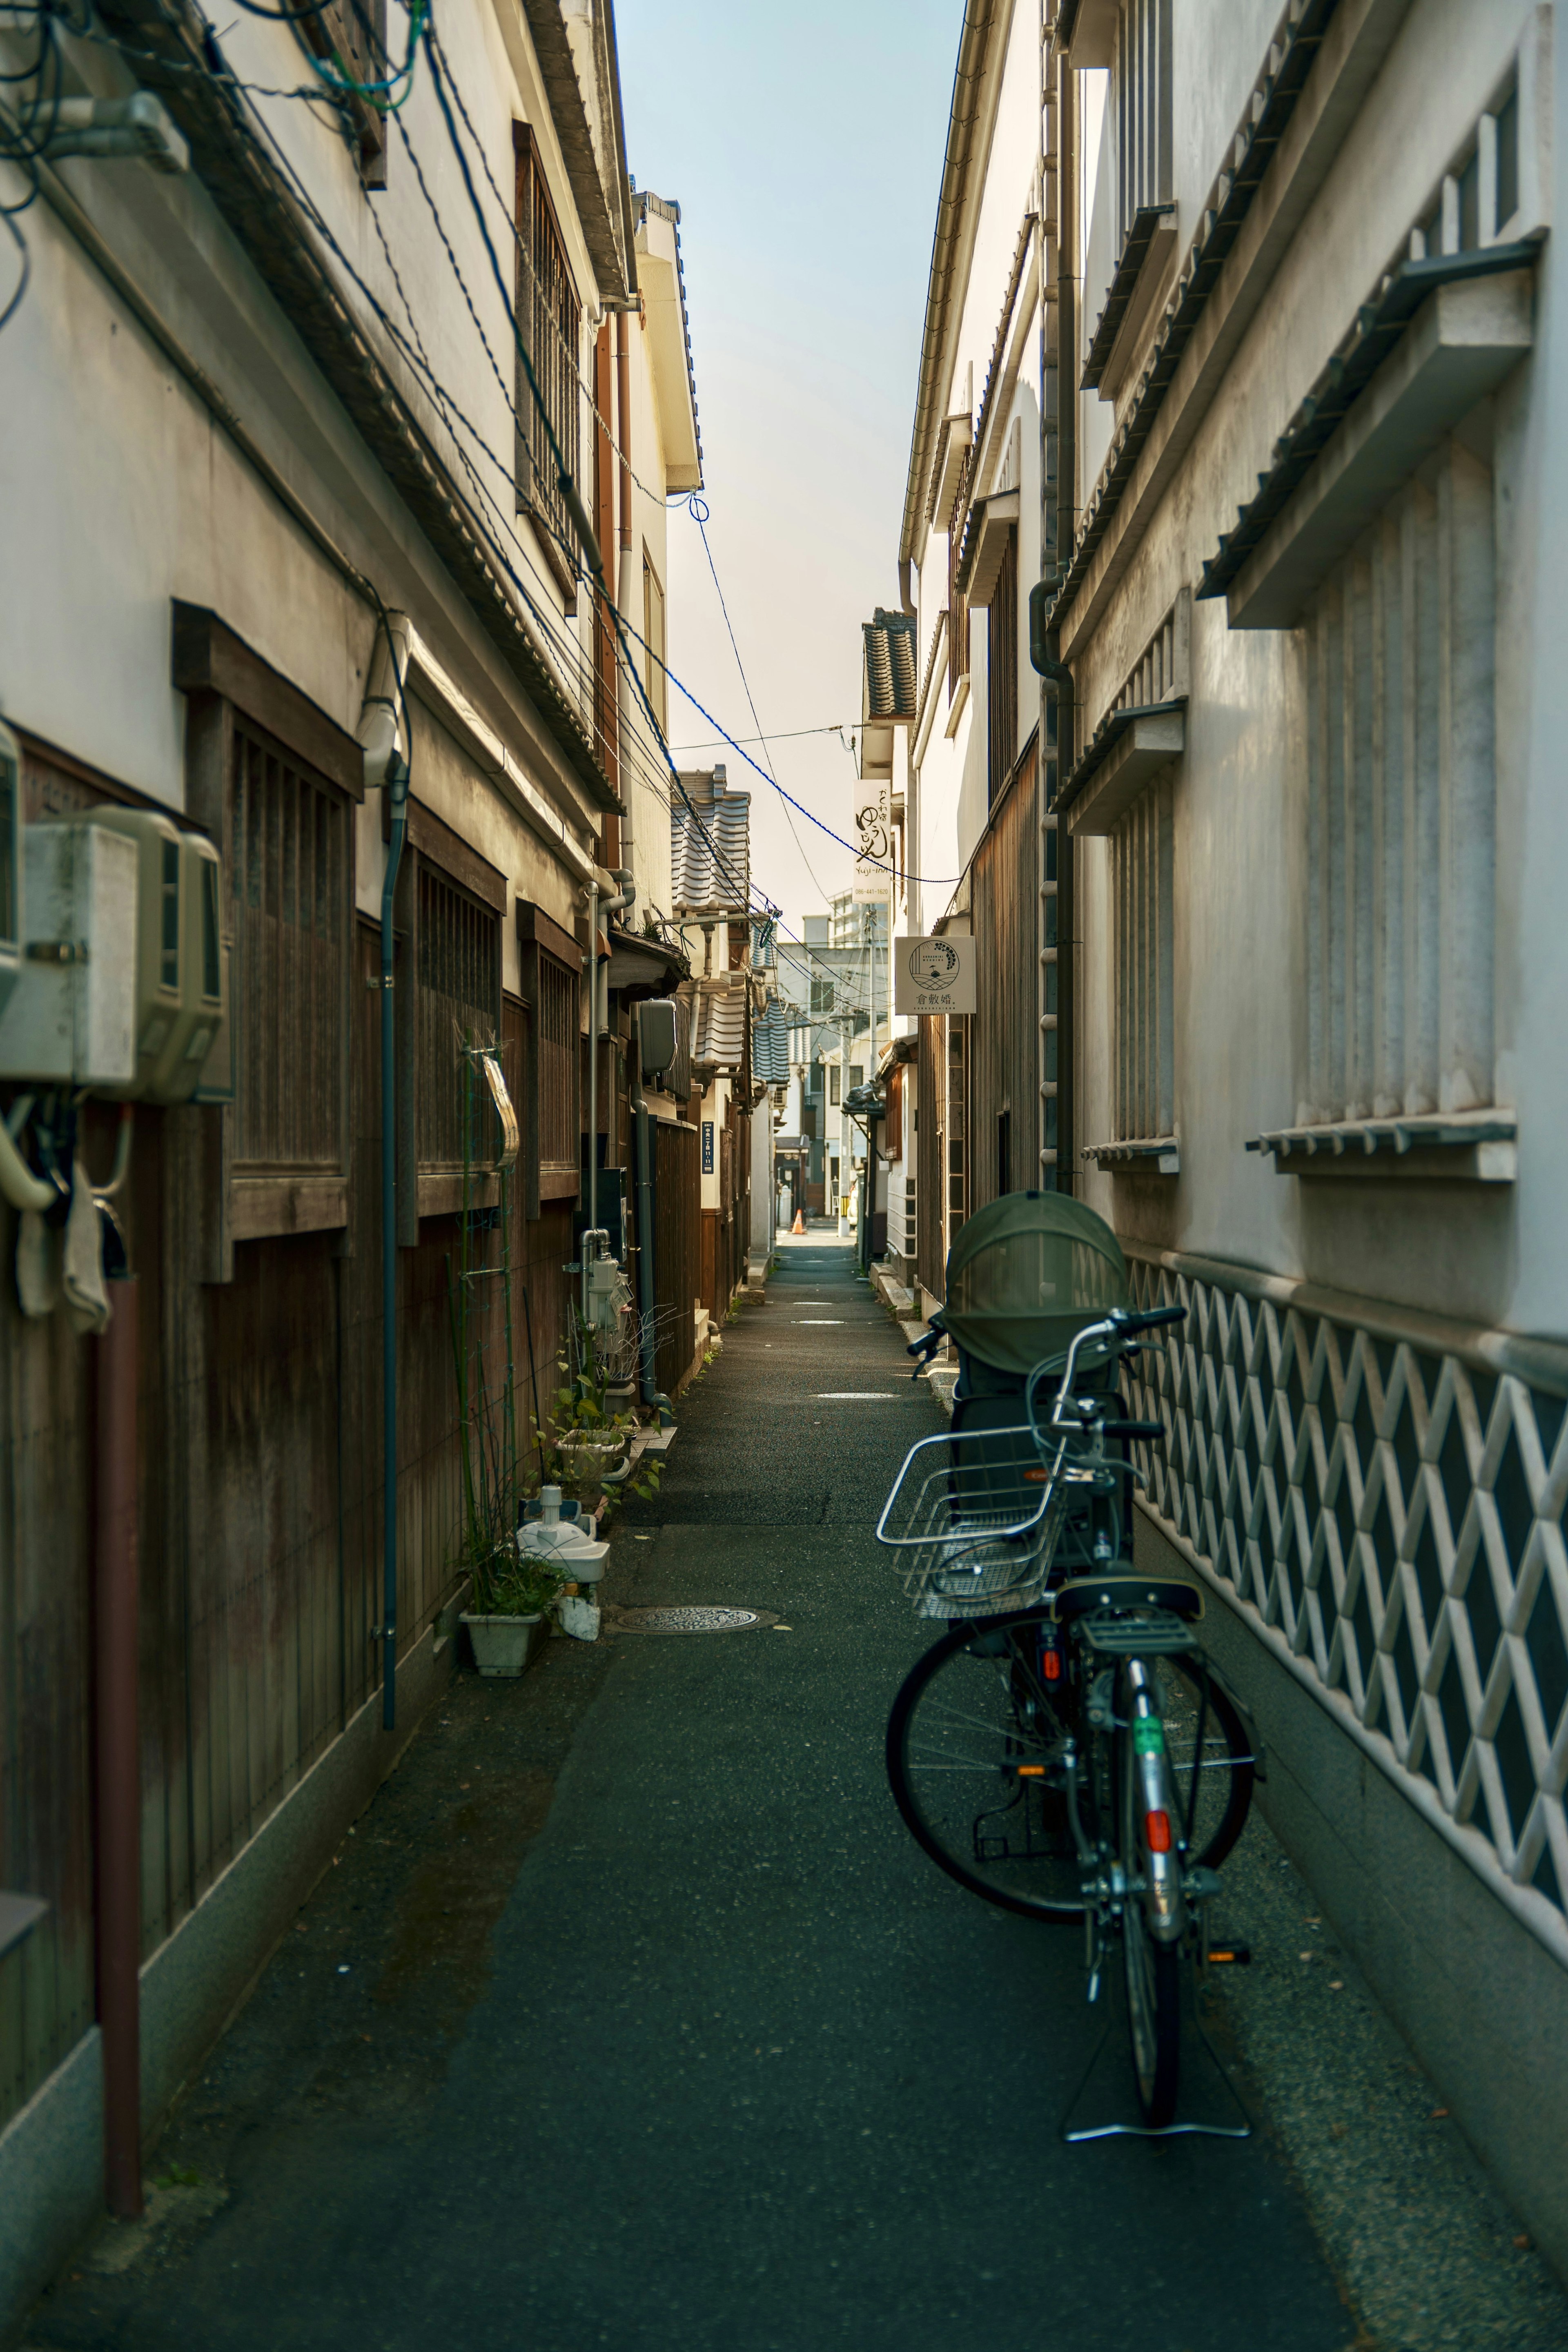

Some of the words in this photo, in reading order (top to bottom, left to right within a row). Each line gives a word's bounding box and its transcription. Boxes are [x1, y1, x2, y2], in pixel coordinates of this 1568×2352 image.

[878, 789, 887, 822] かくれ宿
[856, 866, 888, 876] Yuji-inn
